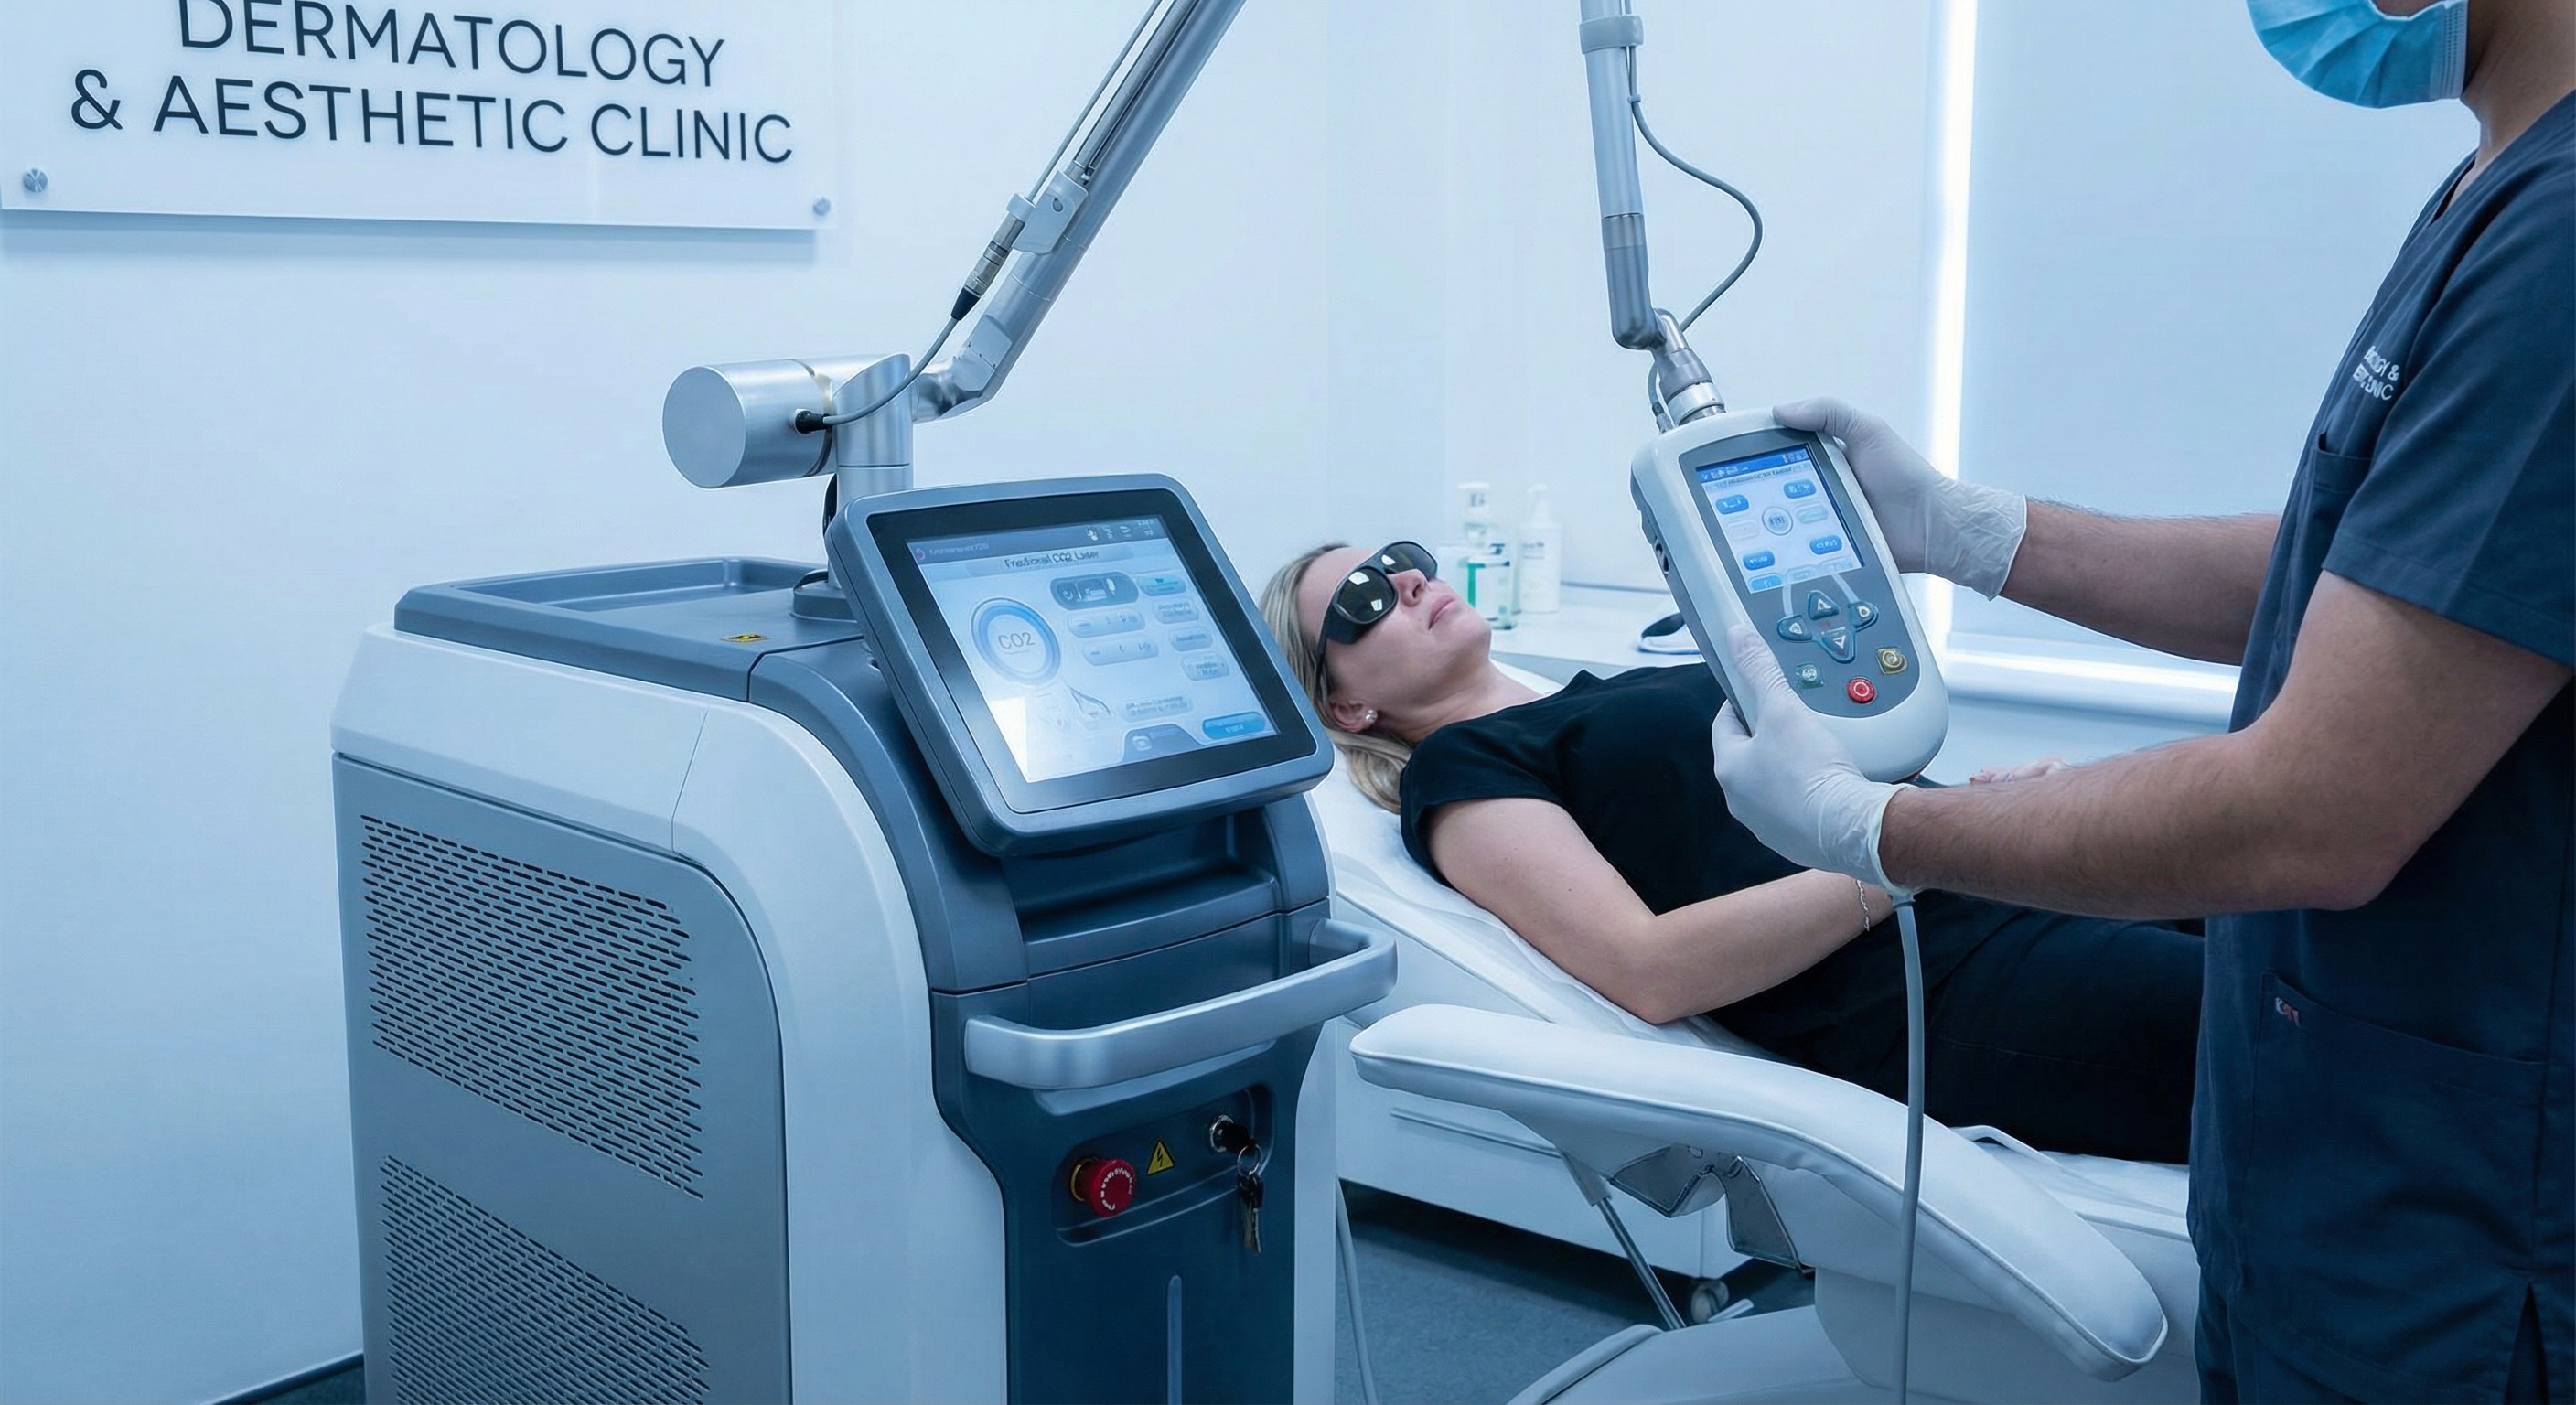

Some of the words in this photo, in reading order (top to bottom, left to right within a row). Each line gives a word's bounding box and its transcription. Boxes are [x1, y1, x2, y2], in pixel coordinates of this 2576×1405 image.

[179, 0, 724, 87] DERMATOLOGY
[70, 69, 123, 131] &
[154, 76, 568, 153] AESTHETIC
[591, 103, 792, 164] CLINIC
[997, 632, 1036, 649] CO2
